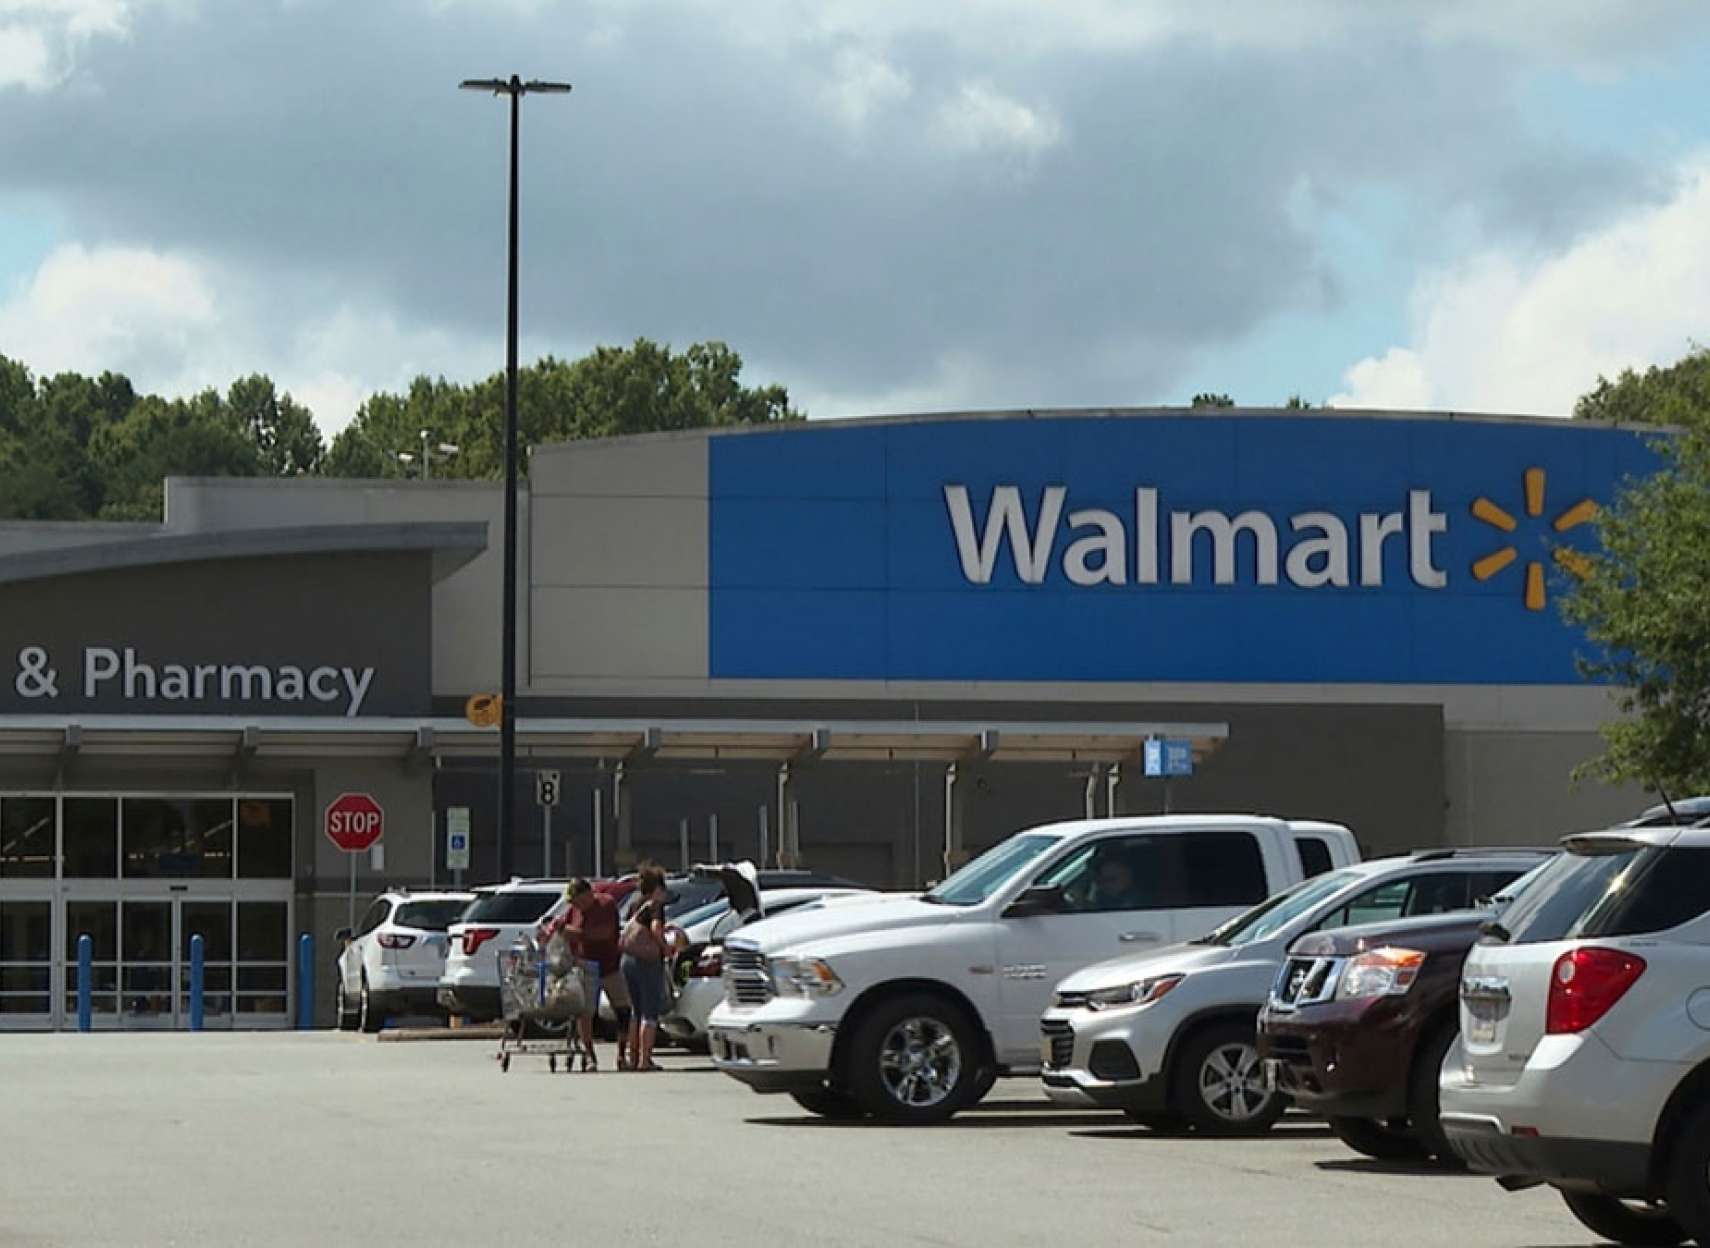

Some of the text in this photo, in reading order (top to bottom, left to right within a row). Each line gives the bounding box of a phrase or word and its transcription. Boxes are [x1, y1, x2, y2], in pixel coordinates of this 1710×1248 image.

[943, 485, 1447, 589] Walmart
[15, 647, 374, 717] & Pharmacy
[330, 811, 380, 833] STOP
